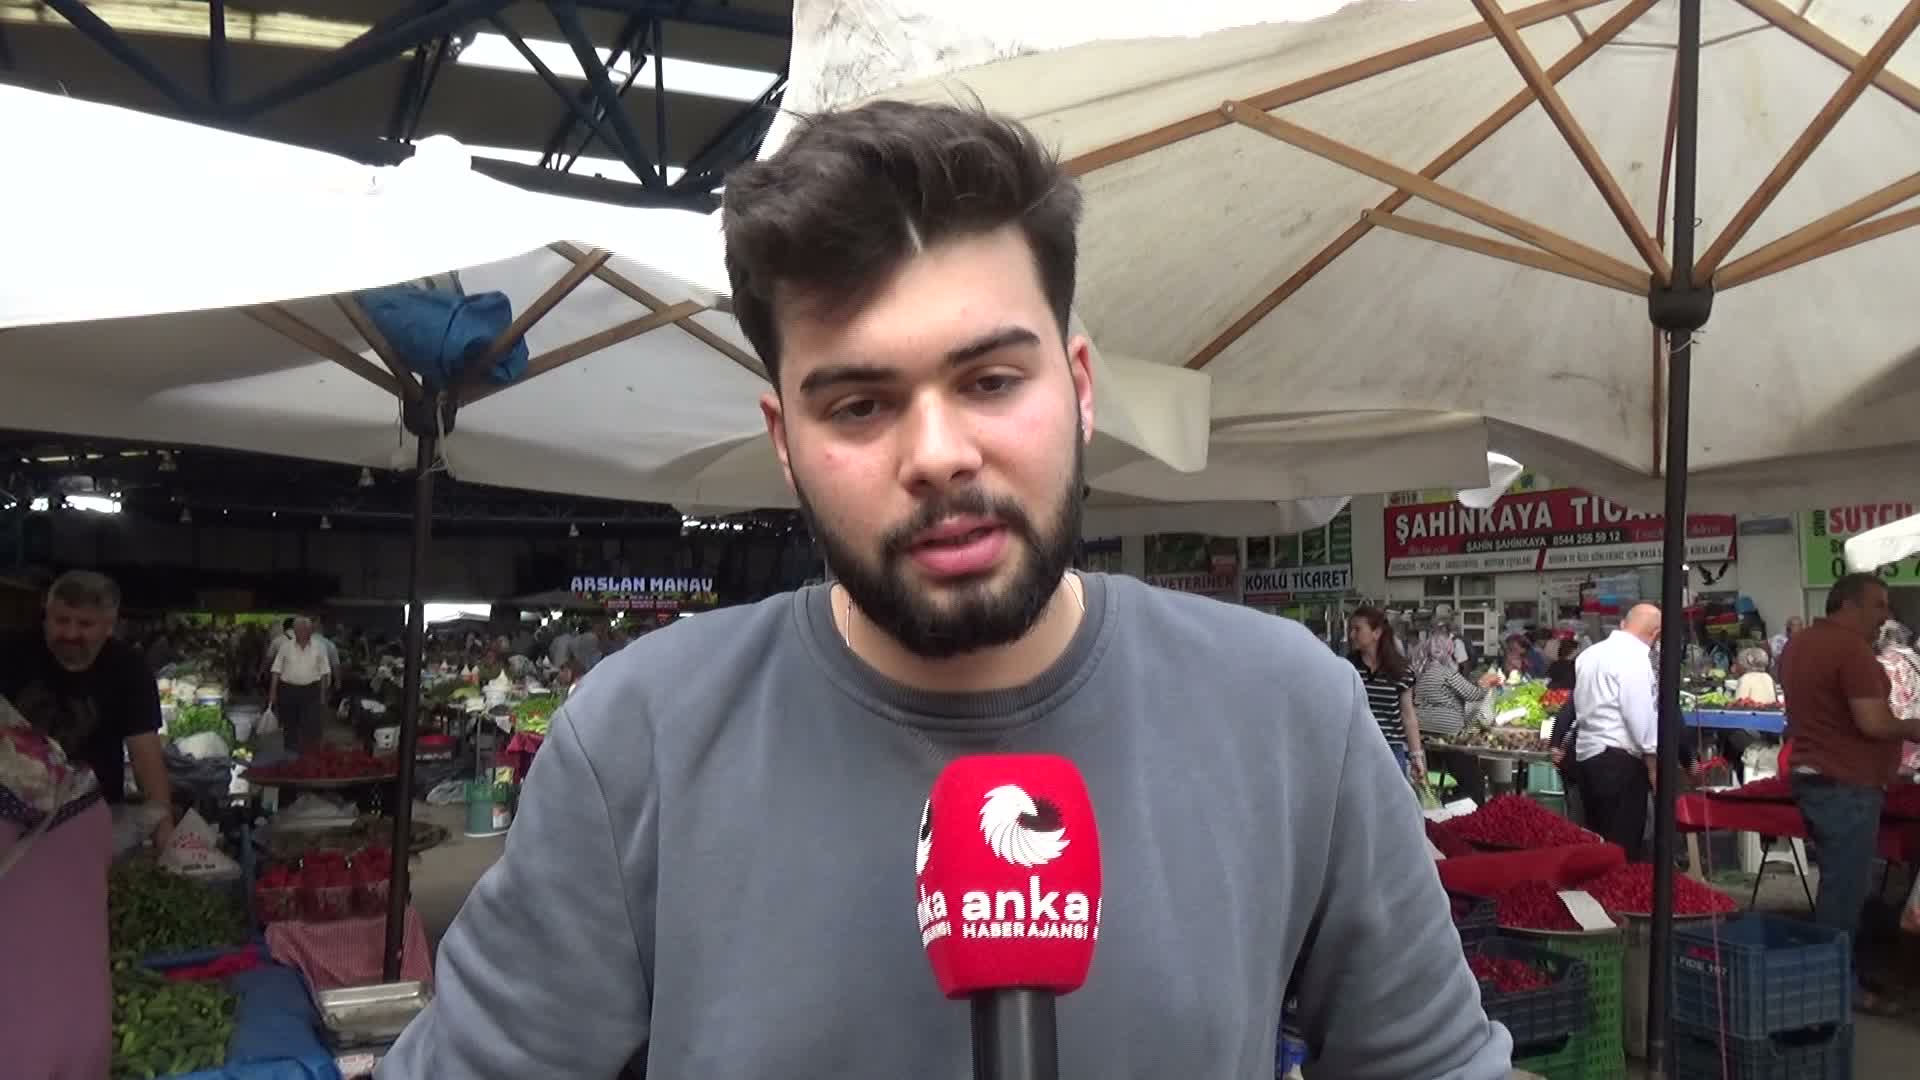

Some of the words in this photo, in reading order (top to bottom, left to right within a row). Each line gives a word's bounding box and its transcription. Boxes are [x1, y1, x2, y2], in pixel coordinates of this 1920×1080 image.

[1395, 500, 1553, 545] ŞAHİNKAYA
[1609, 530, 1621, 542] 12
[570, 576, 645, 593] ARSLAN
[961, 875, 1090, 921] anka
[962, 921, 1026, 938] HABER
[1027, 921, 1089, 940] AJANSI
